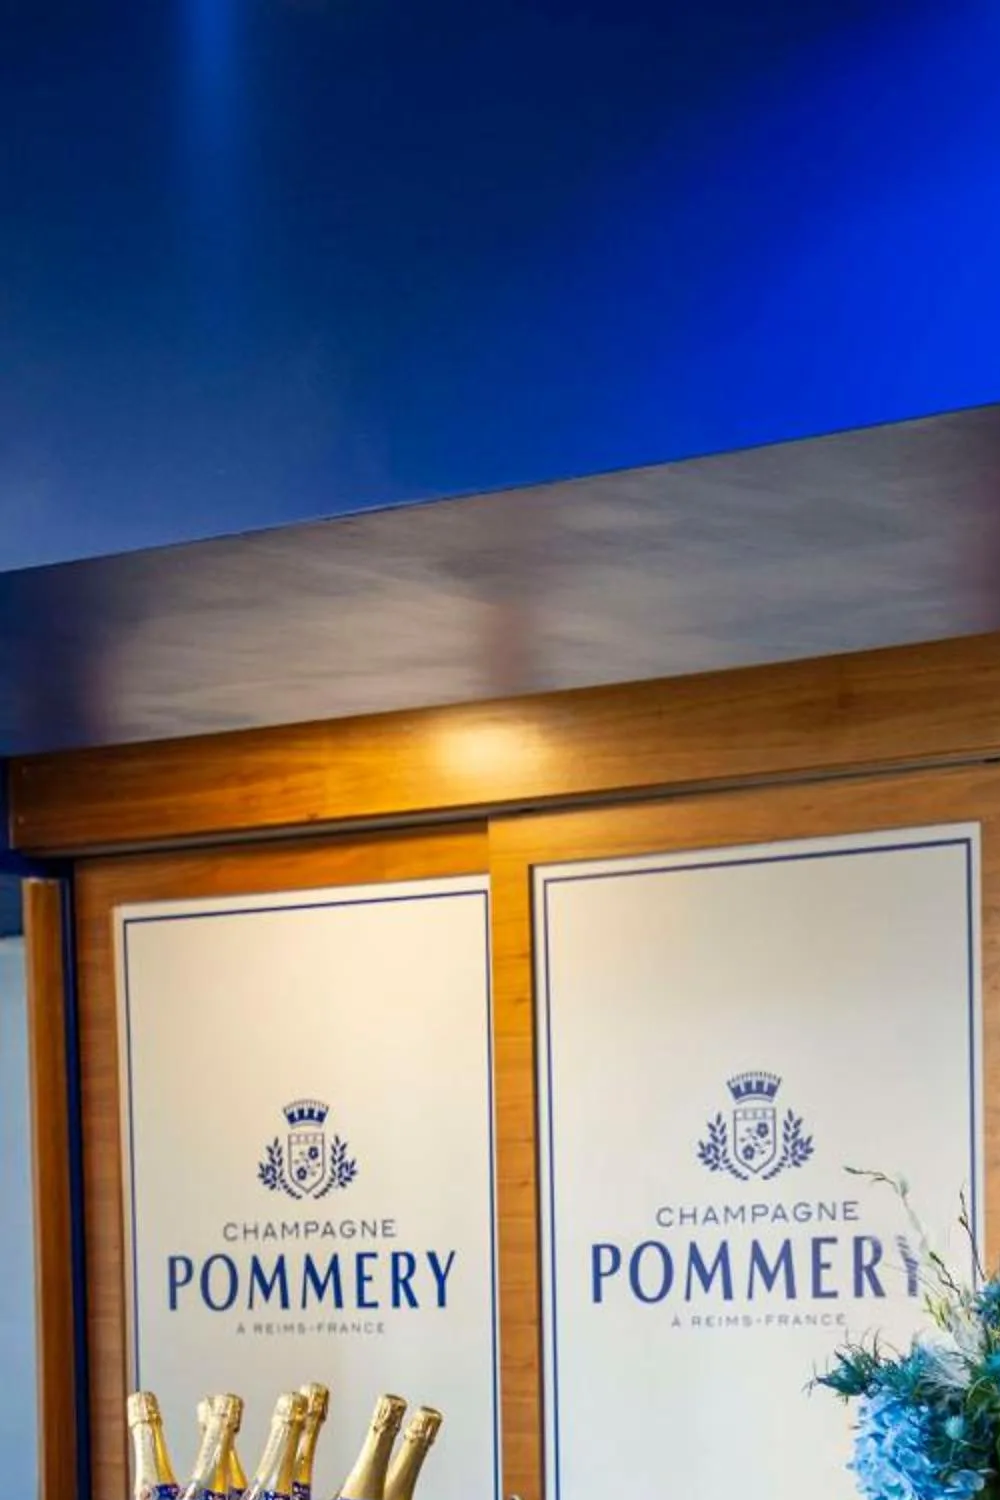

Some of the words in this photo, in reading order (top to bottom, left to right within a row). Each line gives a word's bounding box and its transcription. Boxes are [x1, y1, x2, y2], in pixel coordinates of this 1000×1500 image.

[656, 1200, 860, 1228] CHAMPAGNE
[222, 1218, 397, 1242] CHAMPAGNE
[167, 1249, 456, 1312] POMMERY
